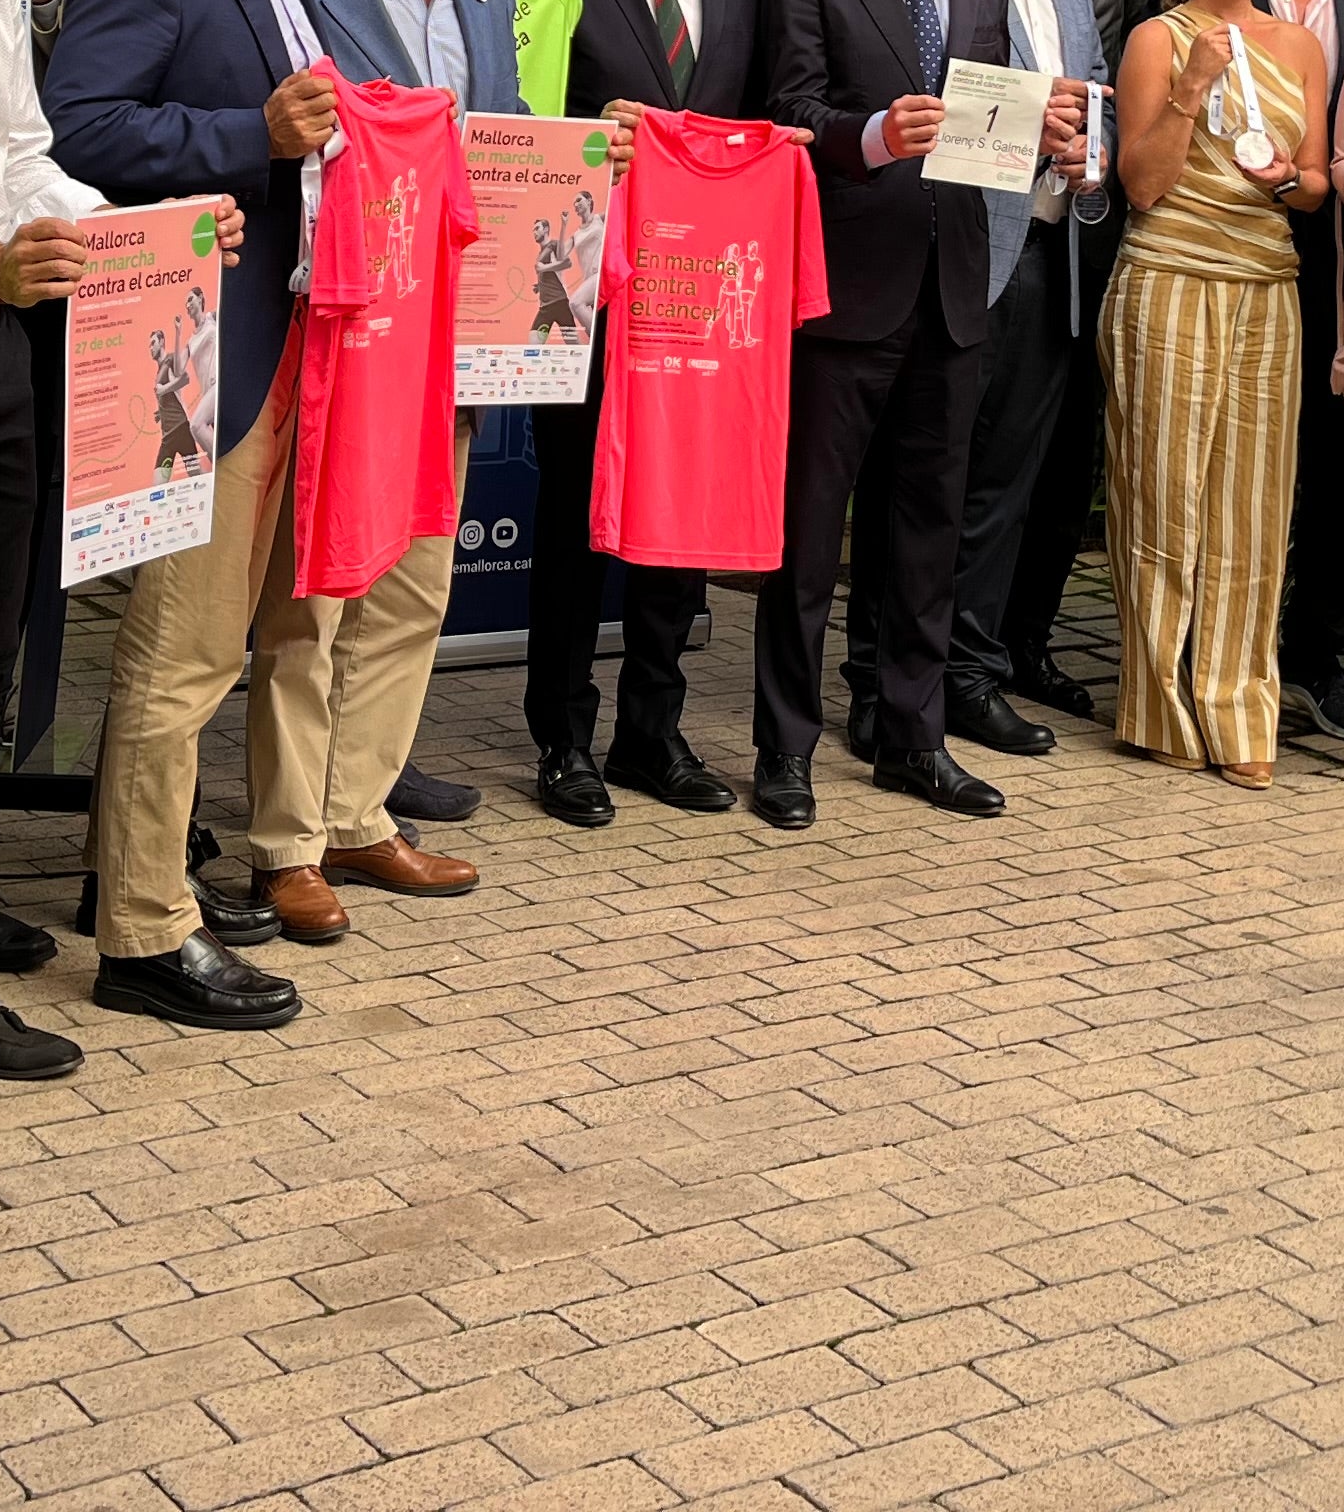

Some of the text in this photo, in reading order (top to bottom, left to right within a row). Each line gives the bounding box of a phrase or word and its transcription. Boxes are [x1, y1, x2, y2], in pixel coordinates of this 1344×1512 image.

[987, 104, 999, 133] 1
[470, 129, 534, 147] Mallorca
[992, 139, 1034, 157] Galmés
[467, 151, 544, 165] en marcha
[515, 168, 529, 183] el
[532, 169, 582, 185] cáncer
[84, 230, 145, 252] Mallorca
[102, 250, 155, 272] marcha
[635, 248, 738, 277] En marcha
[78, 267, 193, 299] contra el cáncer
[632, 276, 697, 297] contra
[630, 297, 721, 321] el cáncer
[75, 340, 87, 354] 27
[89, 336, 104, 352] de
[663, 356, 683, 369] OK
